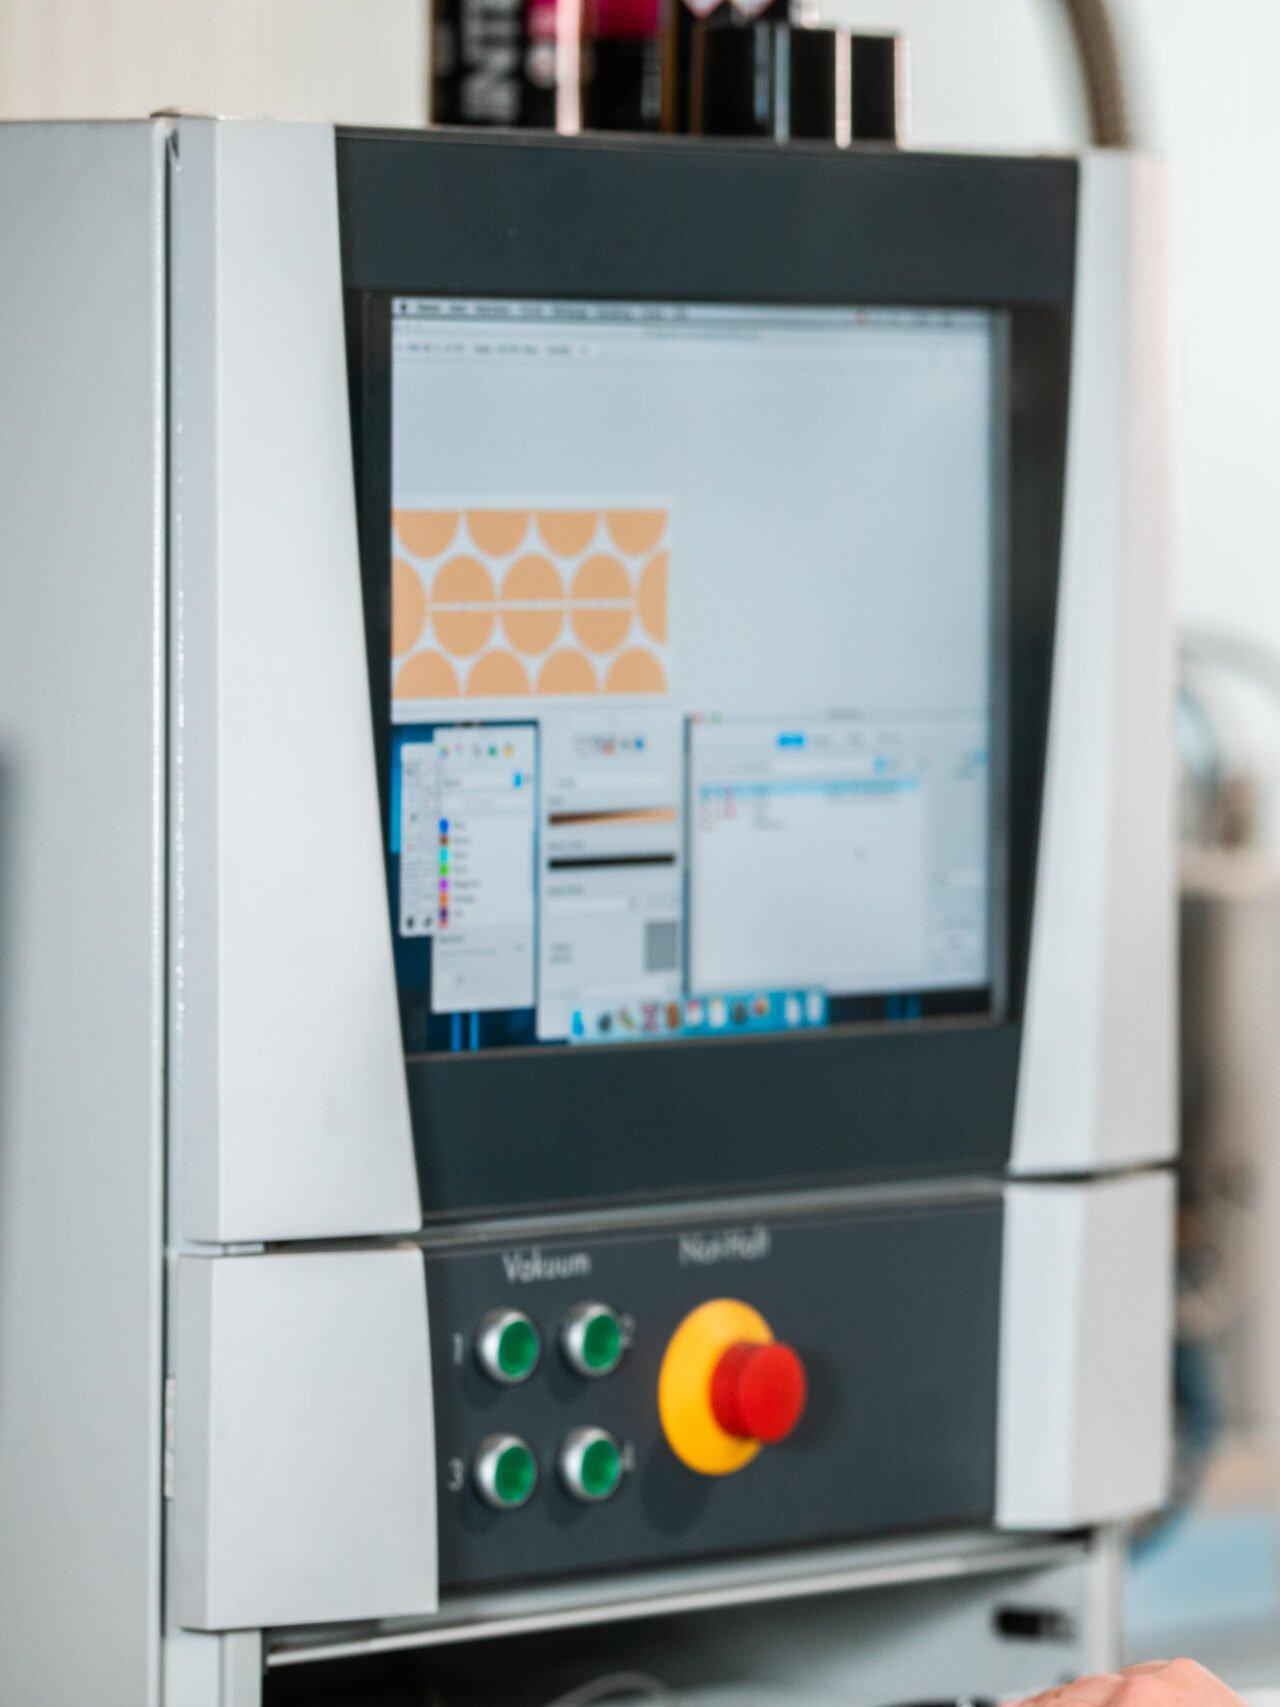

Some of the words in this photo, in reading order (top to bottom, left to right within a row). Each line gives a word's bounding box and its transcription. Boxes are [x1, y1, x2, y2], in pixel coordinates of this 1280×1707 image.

[502, 1247, 591, 1282] Vakuum
[453, 1332, 463, 1365] 1
[449, 1457, 464, 1492] 3
